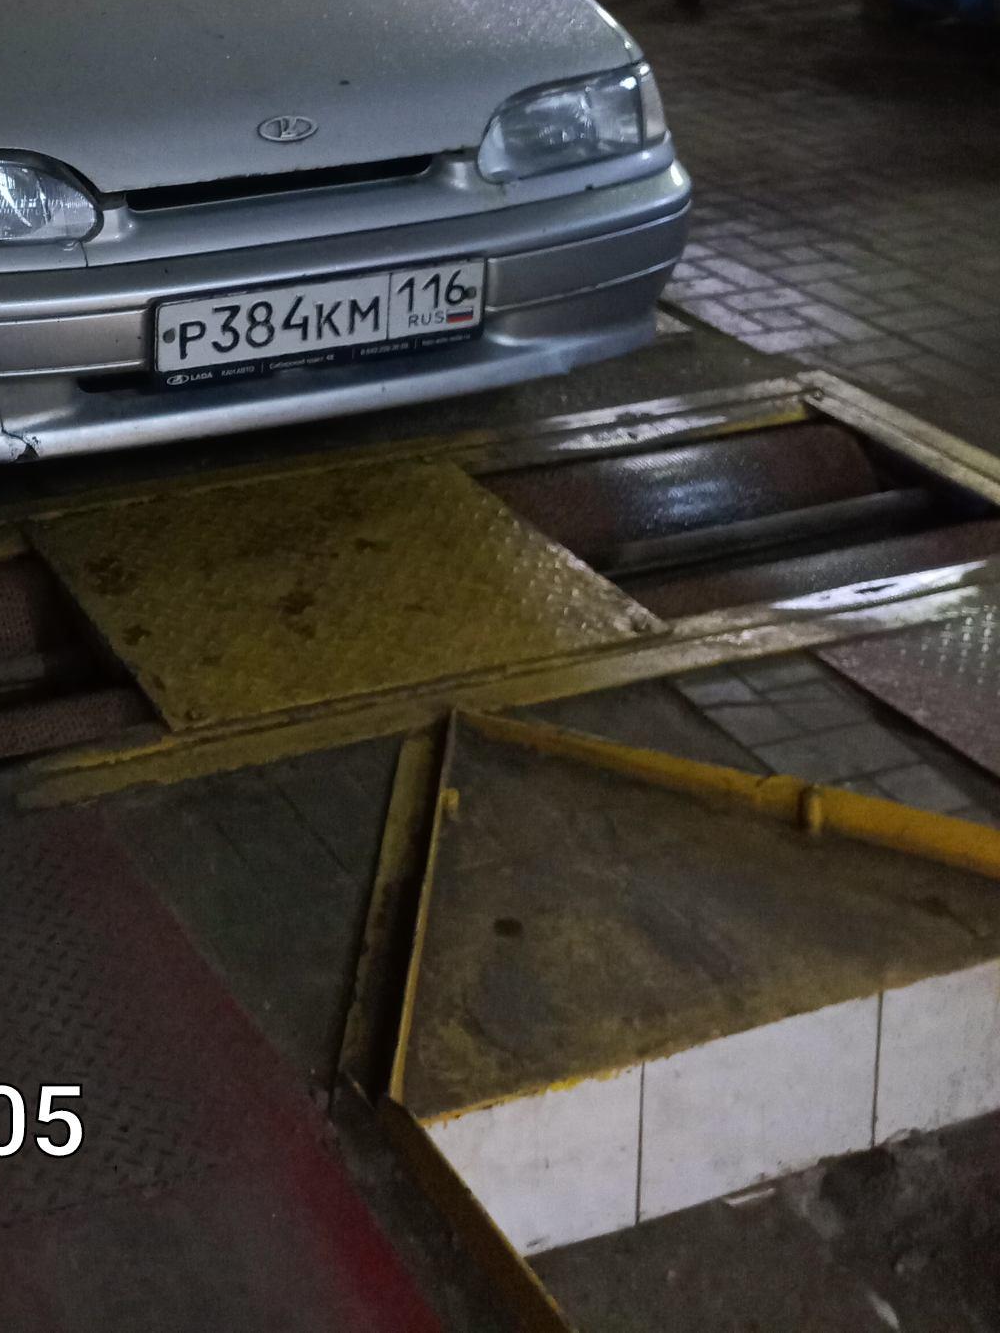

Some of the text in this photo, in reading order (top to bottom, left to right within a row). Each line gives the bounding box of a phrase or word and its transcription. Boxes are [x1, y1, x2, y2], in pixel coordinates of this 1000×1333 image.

[178, 269, 465, 360] Р384КМ 116
[408, 310, 445, 328] RUS
